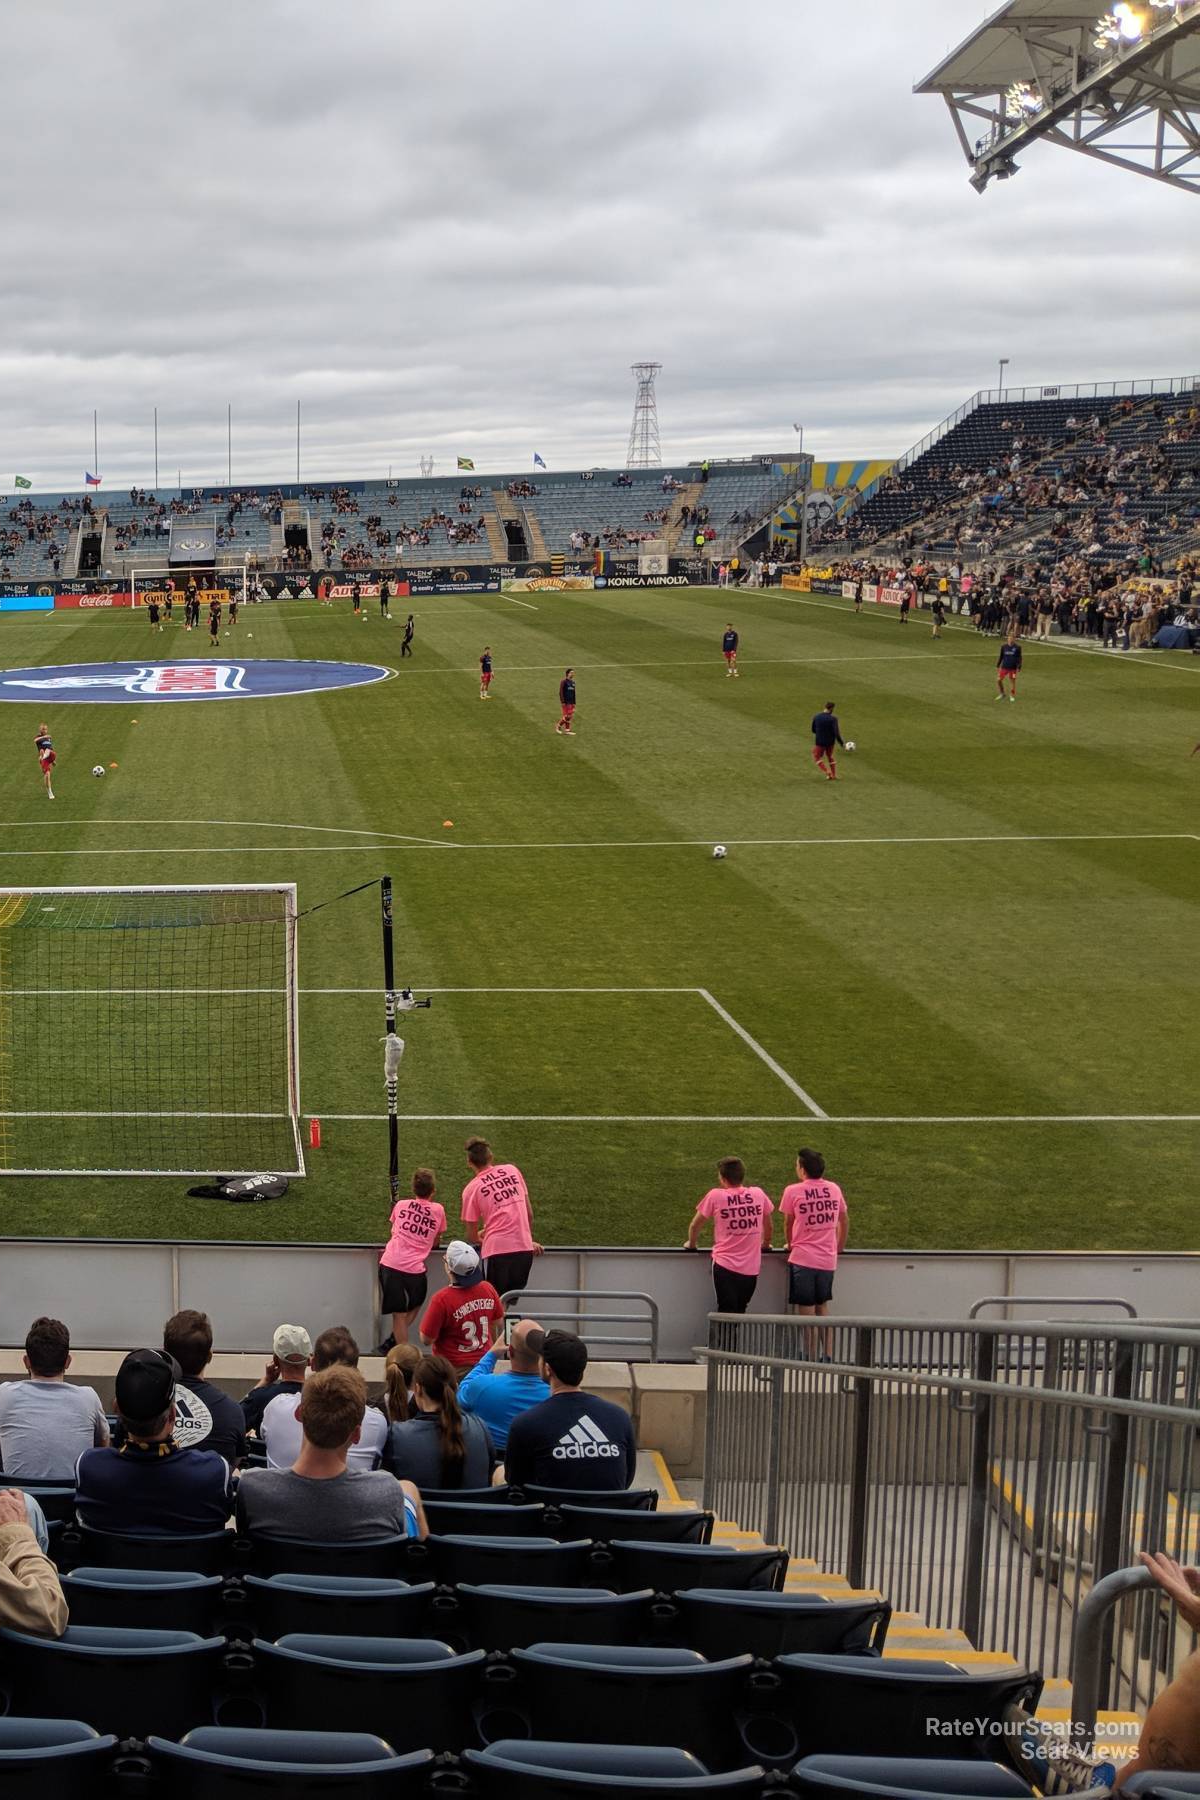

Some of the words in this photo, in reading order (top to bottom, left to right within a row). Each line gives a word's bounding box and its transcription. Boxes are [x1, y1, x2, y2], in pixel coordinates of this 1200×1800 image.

[607, 577, 646, 587] KONICA
[647, 575, 689, 585] MINOLTA
[482, 1169, 507, 1184] MLS
[481, 1175, 520, 1197] STORE
[494, 1187, 519, 1205] .COM
[727, 1194, 754, 1206] MLS
[805, 1188, 831, 1200] MLS
[408, 1202, 431, 1216] MLS
[720, 1205, 762, 1219] STORE
[799, 1200, 838, 1214] STORE
[398, 1210, 436, 1230] STORE
[727, 1218, 758, 1230] .COM
[805, 1213, 835, 1226] .COM
[400, 1221, 429, 1238] .COM
[458, 1316, 489, 1352] 31
[175, 1418, 202, 1429] das
[552, 1440, 620, 1459] adidas
